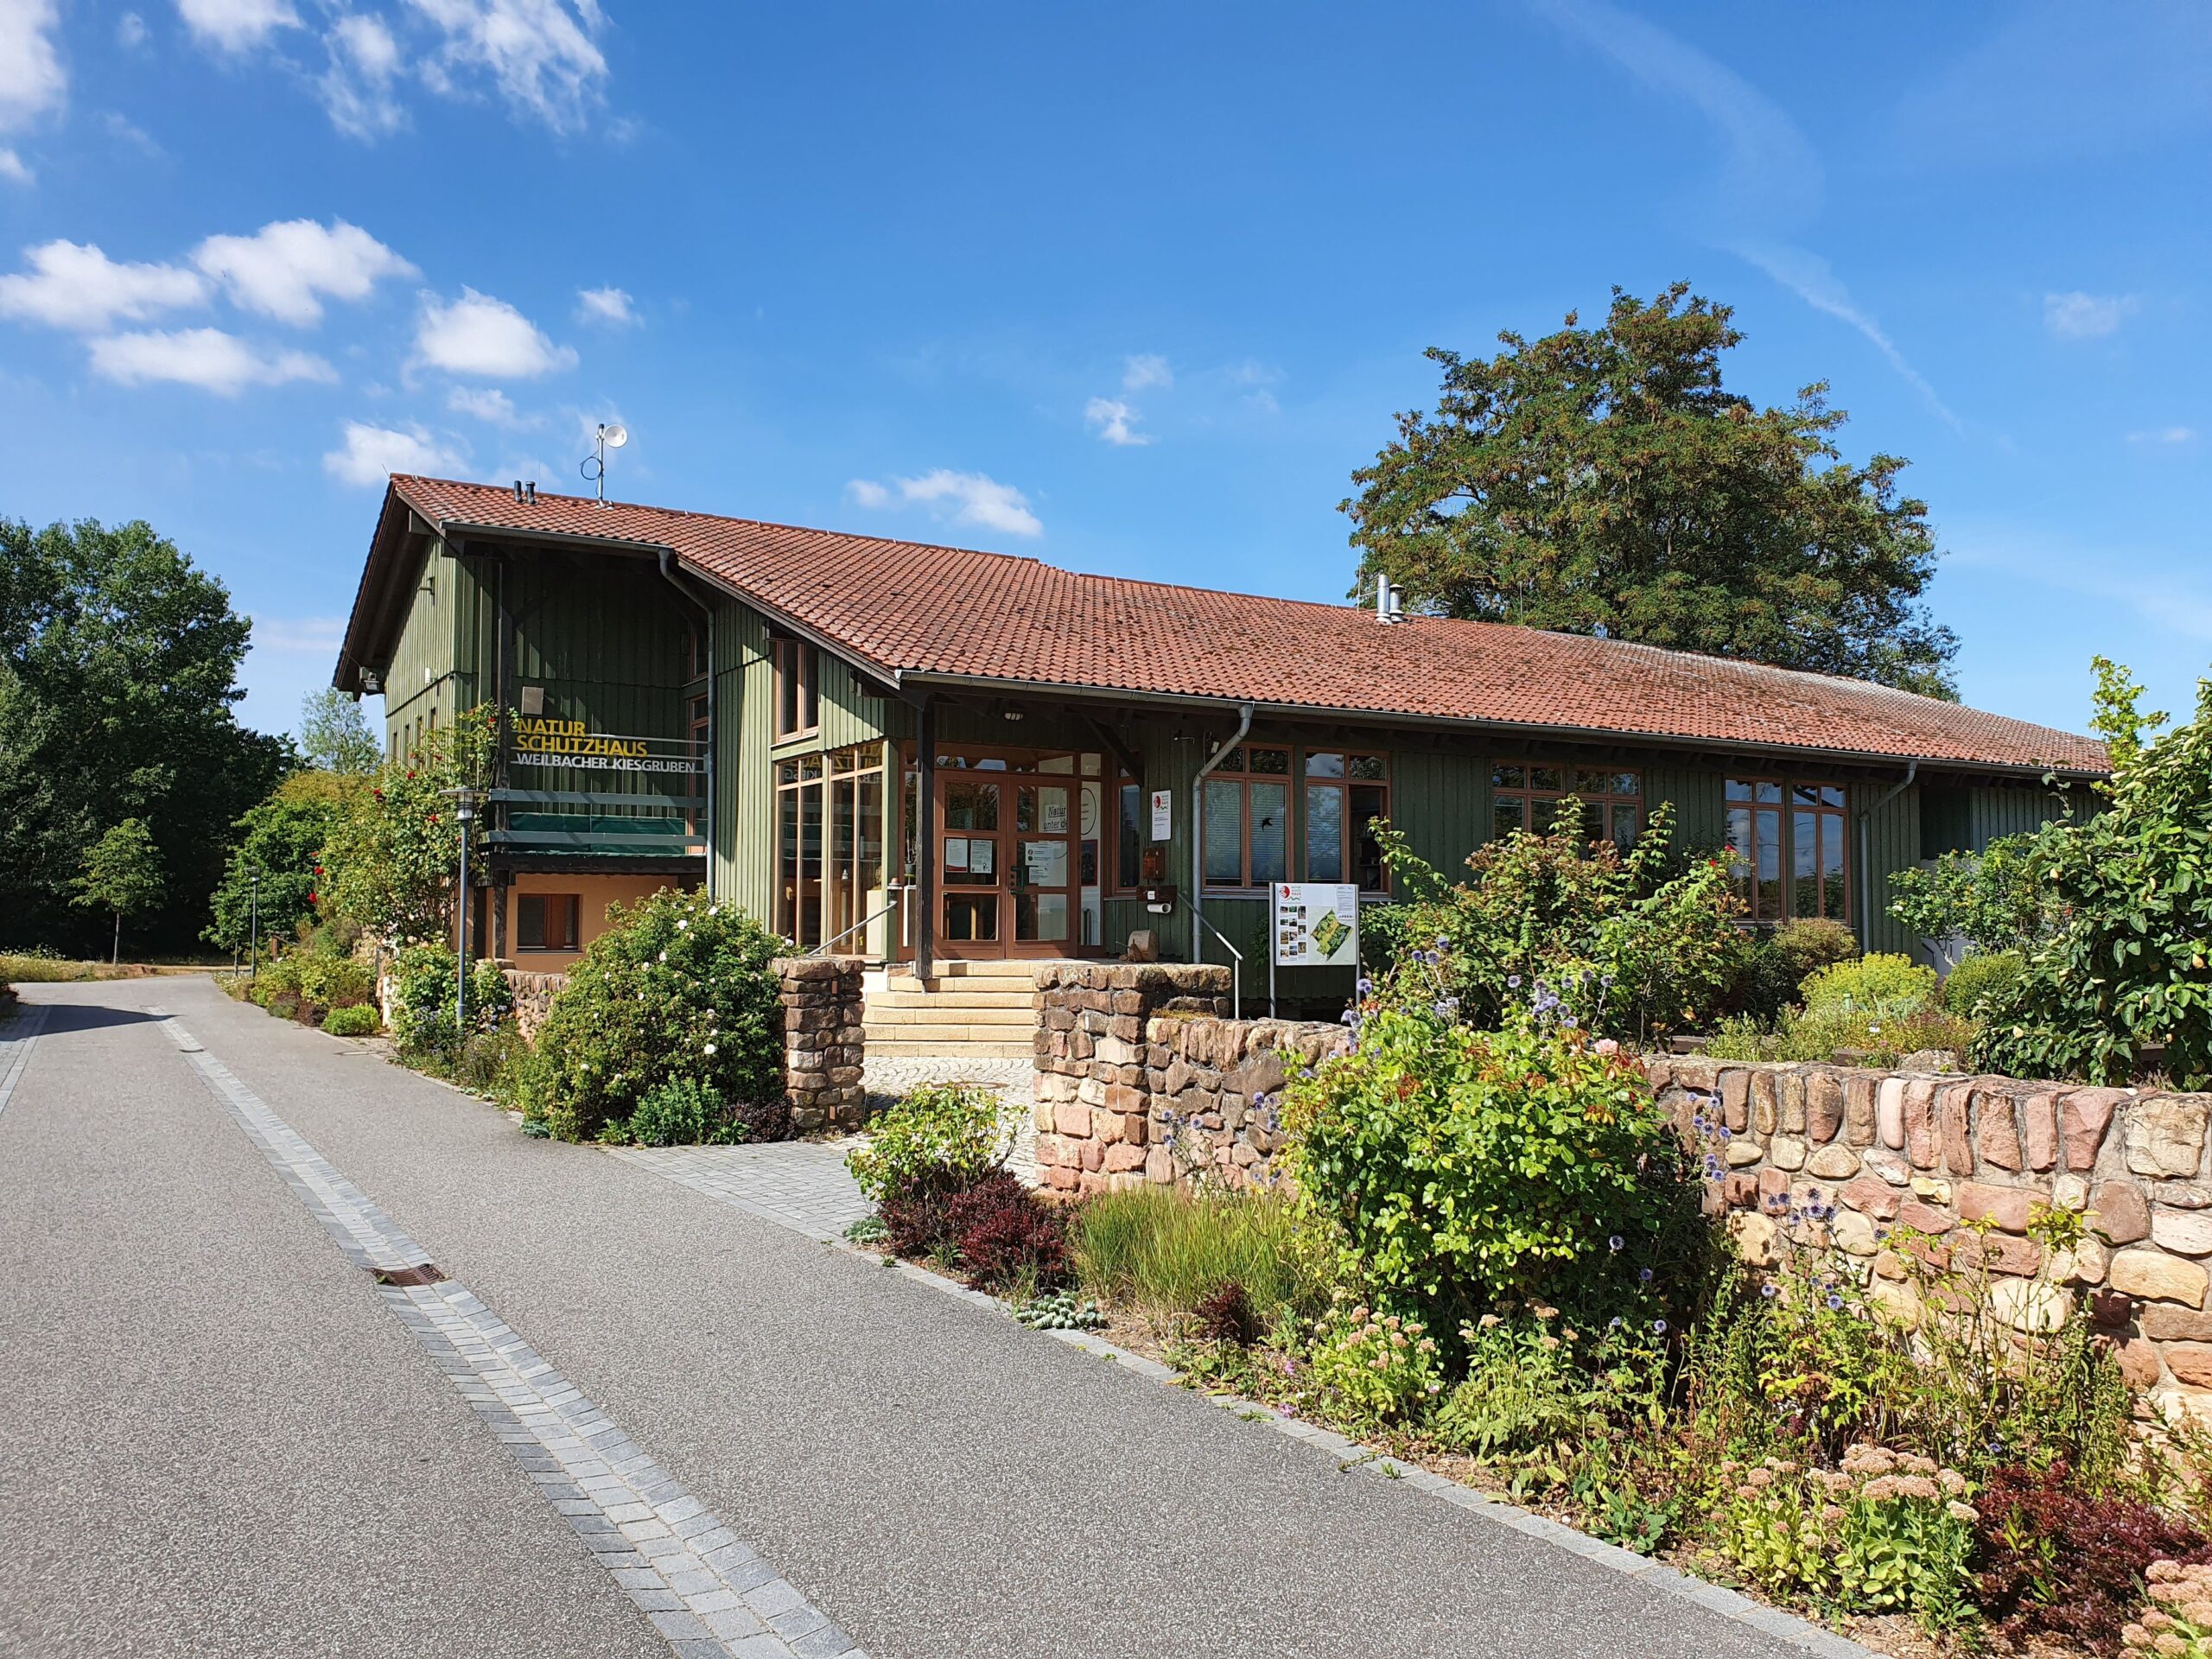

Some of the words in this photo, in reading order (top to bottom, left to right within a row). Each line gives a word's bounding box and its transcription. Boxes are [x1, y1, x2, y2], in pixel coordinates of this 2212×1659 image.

[518, 718, 586, 737] NATUR
[516, 734, 647, 757] SCHUTZHAUS
[517, 753, 607, 769] WEILBACHER
[613, 759, 696, 773] KIESGRUBEN
[1048, 806, 1066, 817] Natur
[1044, 820, 1060, 830] unter
